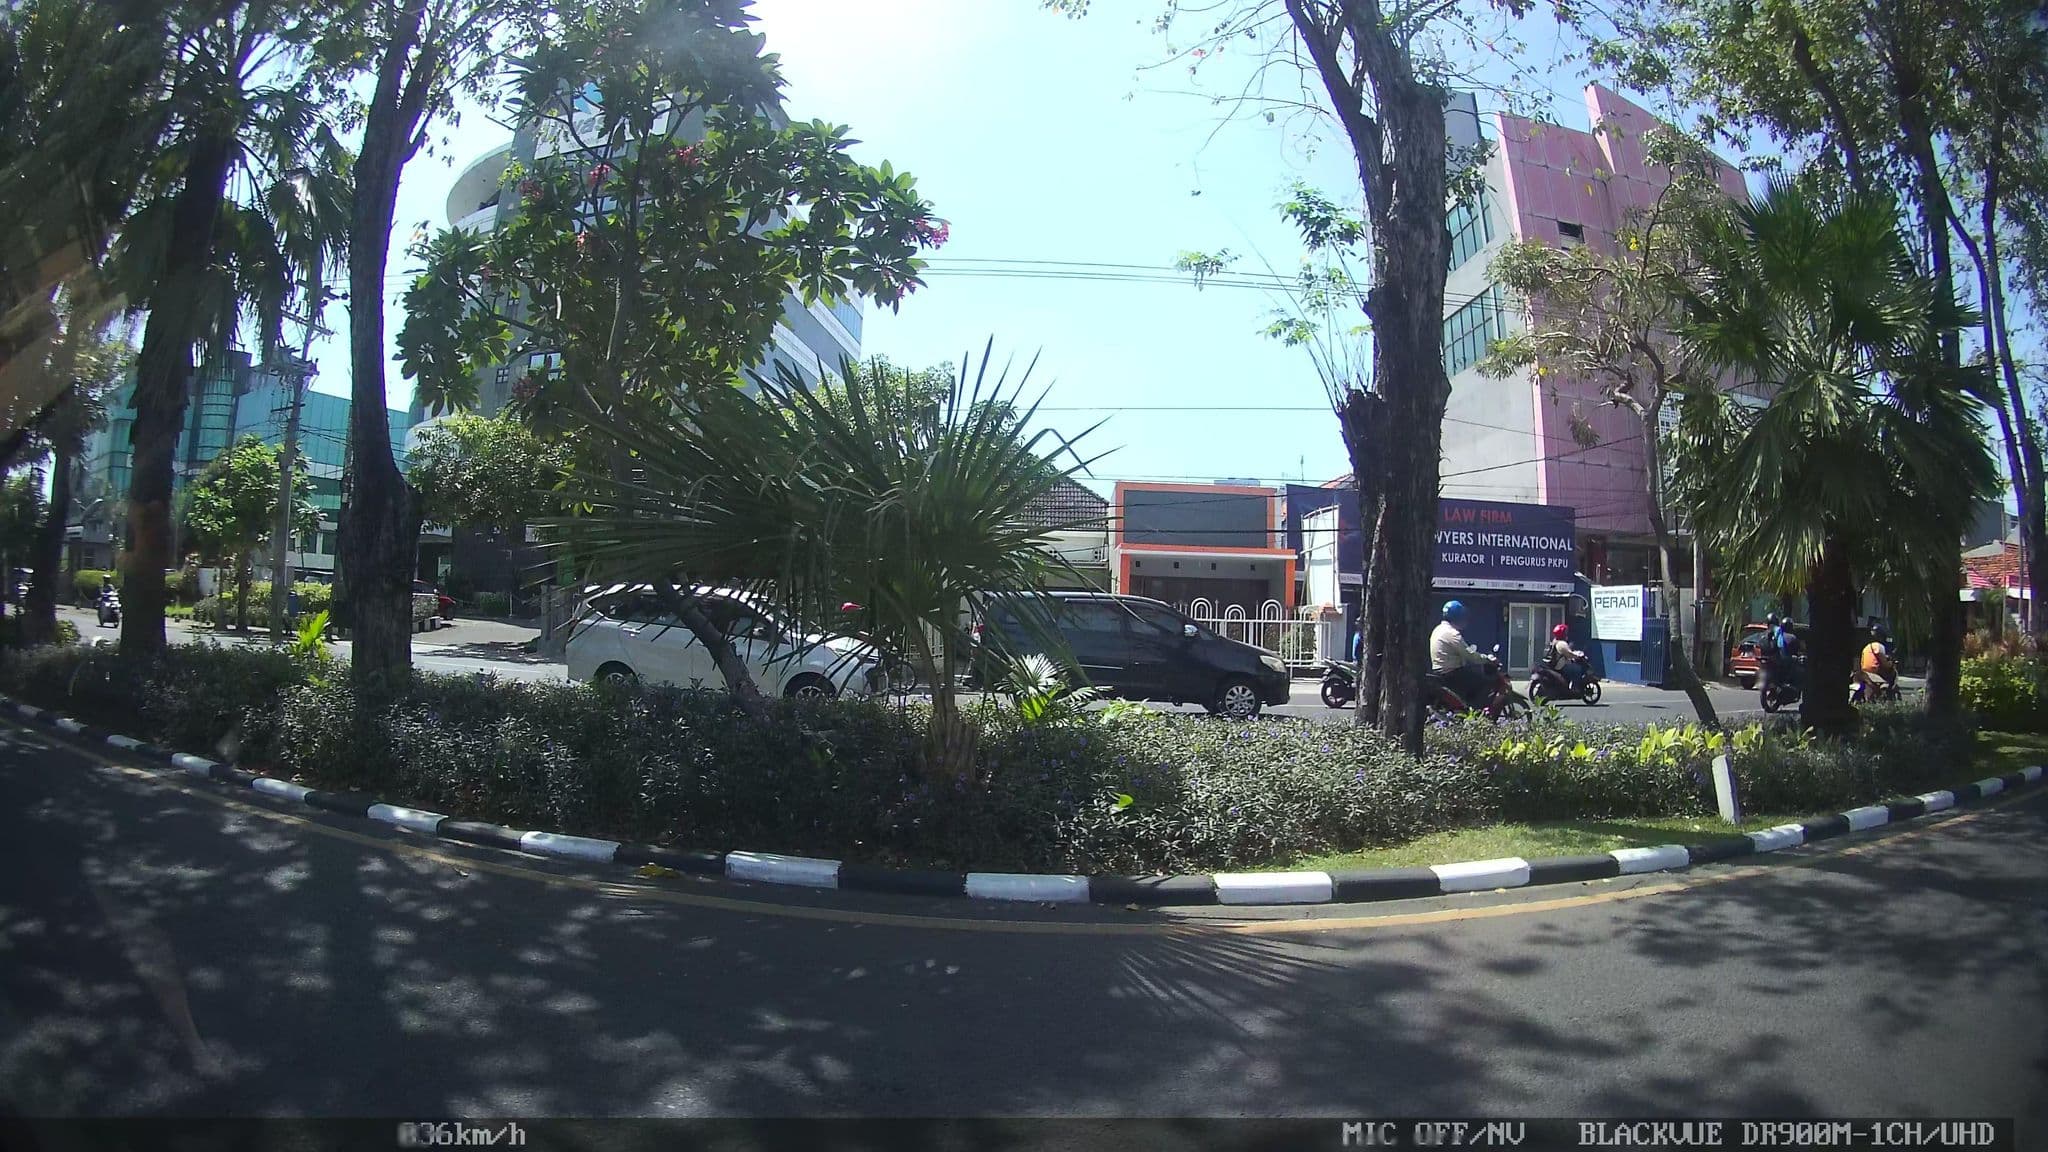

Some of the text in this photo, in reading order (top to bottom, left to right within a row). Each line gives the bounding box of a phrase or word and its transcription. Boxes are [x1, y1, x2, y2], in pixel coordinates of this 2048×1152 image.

[1444, 507, 1513, 523] LAW FIRM
[1478, 532, 1573, 551] INTERNATIONAL
[1441, 552, 1569, 569] KURATOR PENGURUS PKPU
[1594, 595, 1639, 609] PERADI
